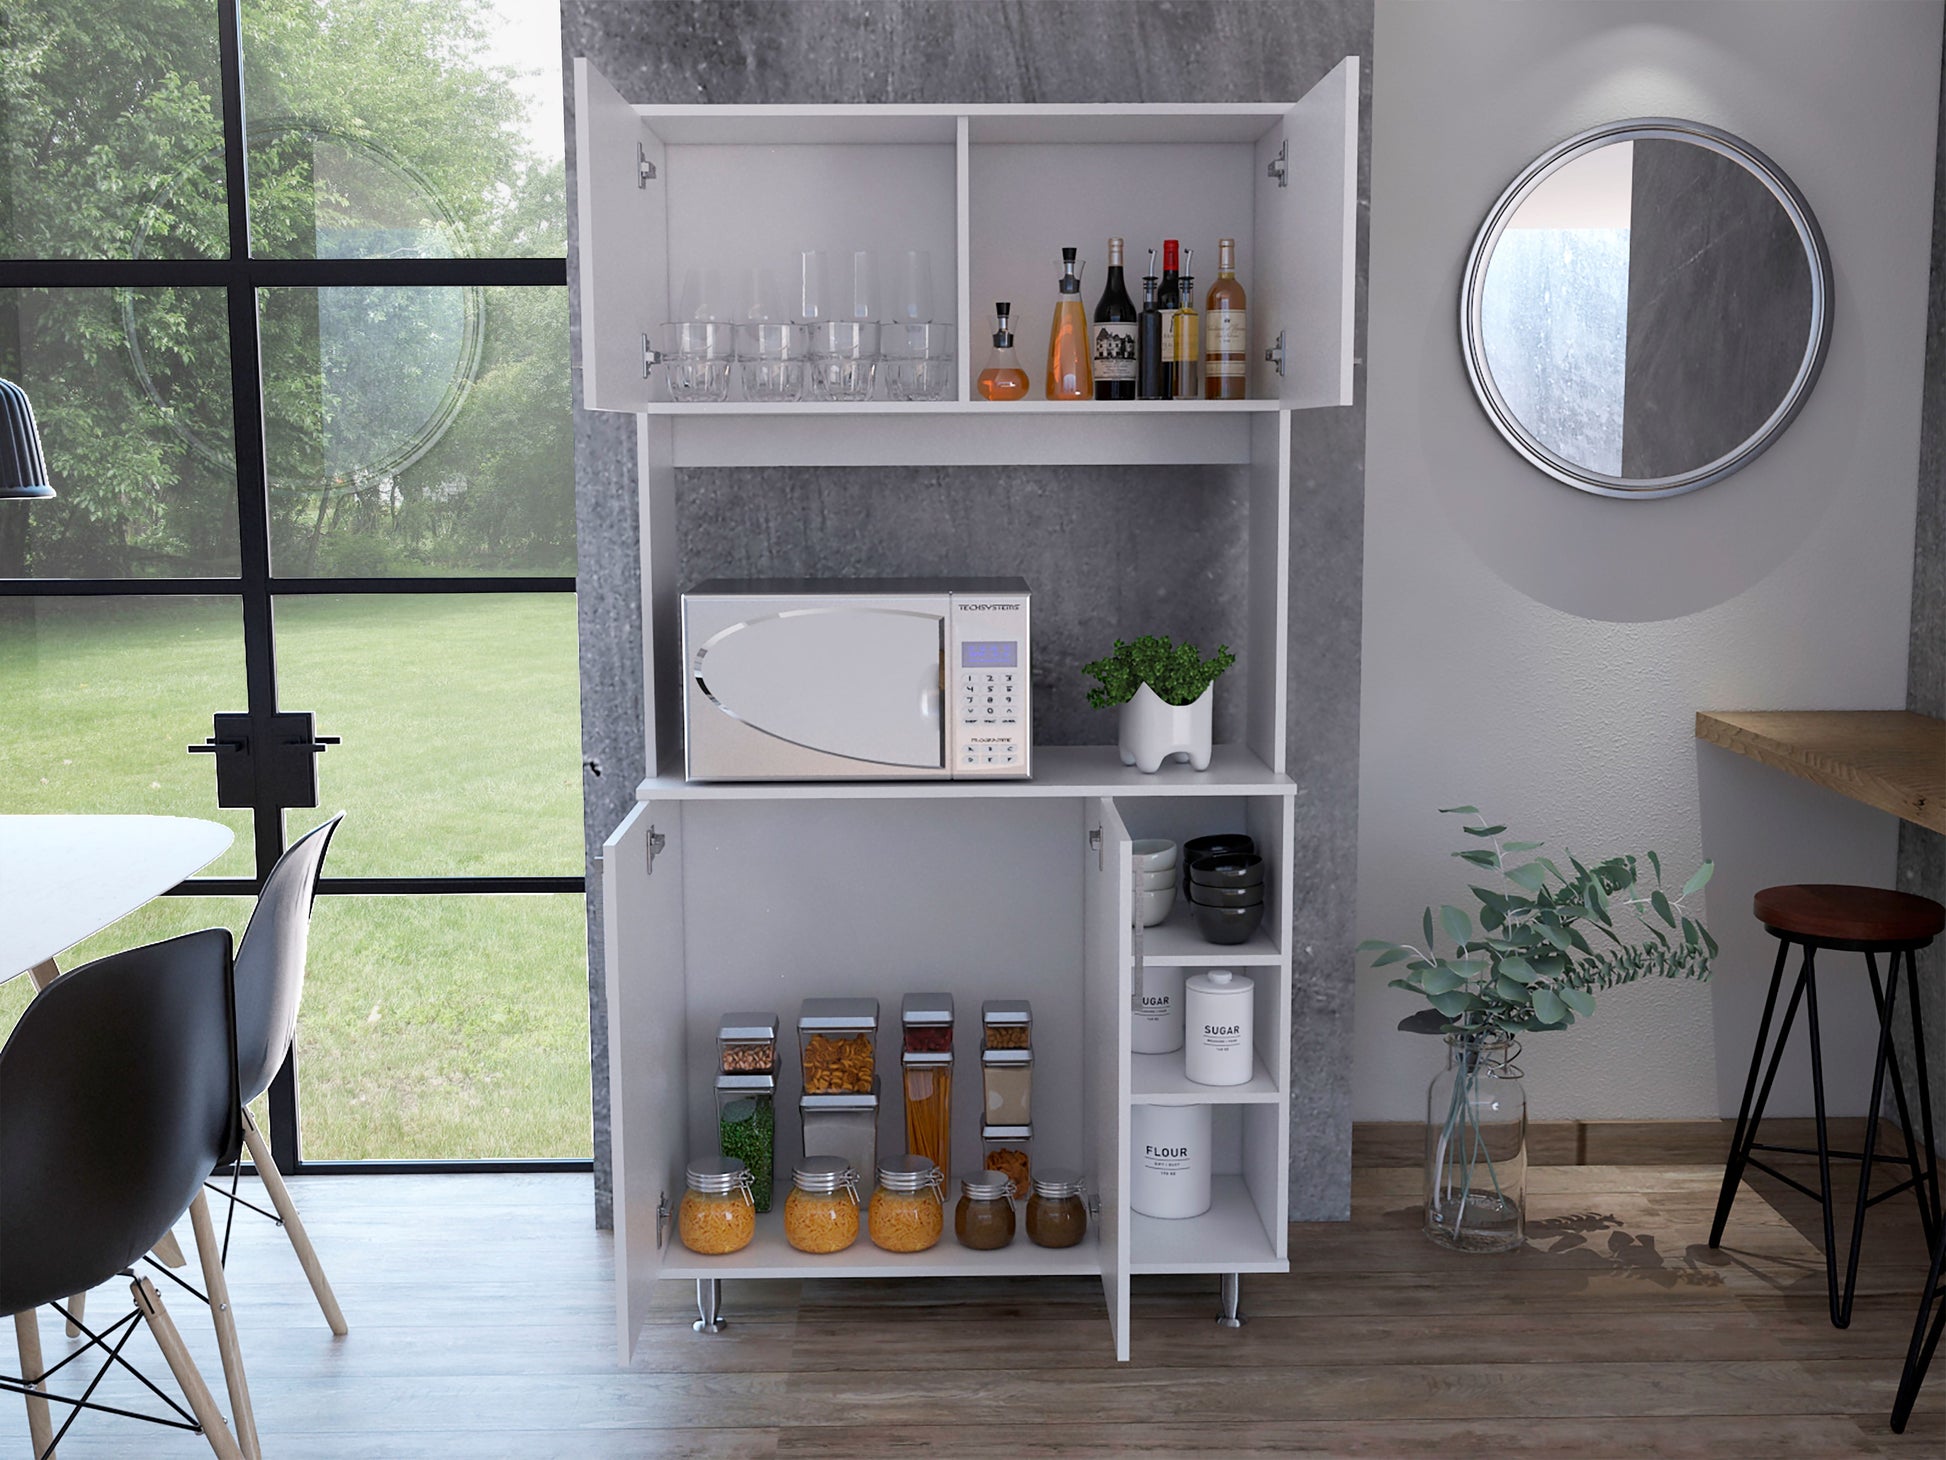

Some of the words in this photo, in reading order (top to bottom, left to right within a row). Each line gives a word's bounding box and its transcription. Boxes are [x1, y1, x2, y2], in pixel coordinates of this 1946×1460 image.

[1142, 996, 1170, 1006] UGAR
[1204, 1025, 1240, 1035] SUGAR
[1146, 1145, 1187, 1157] FLOUR
